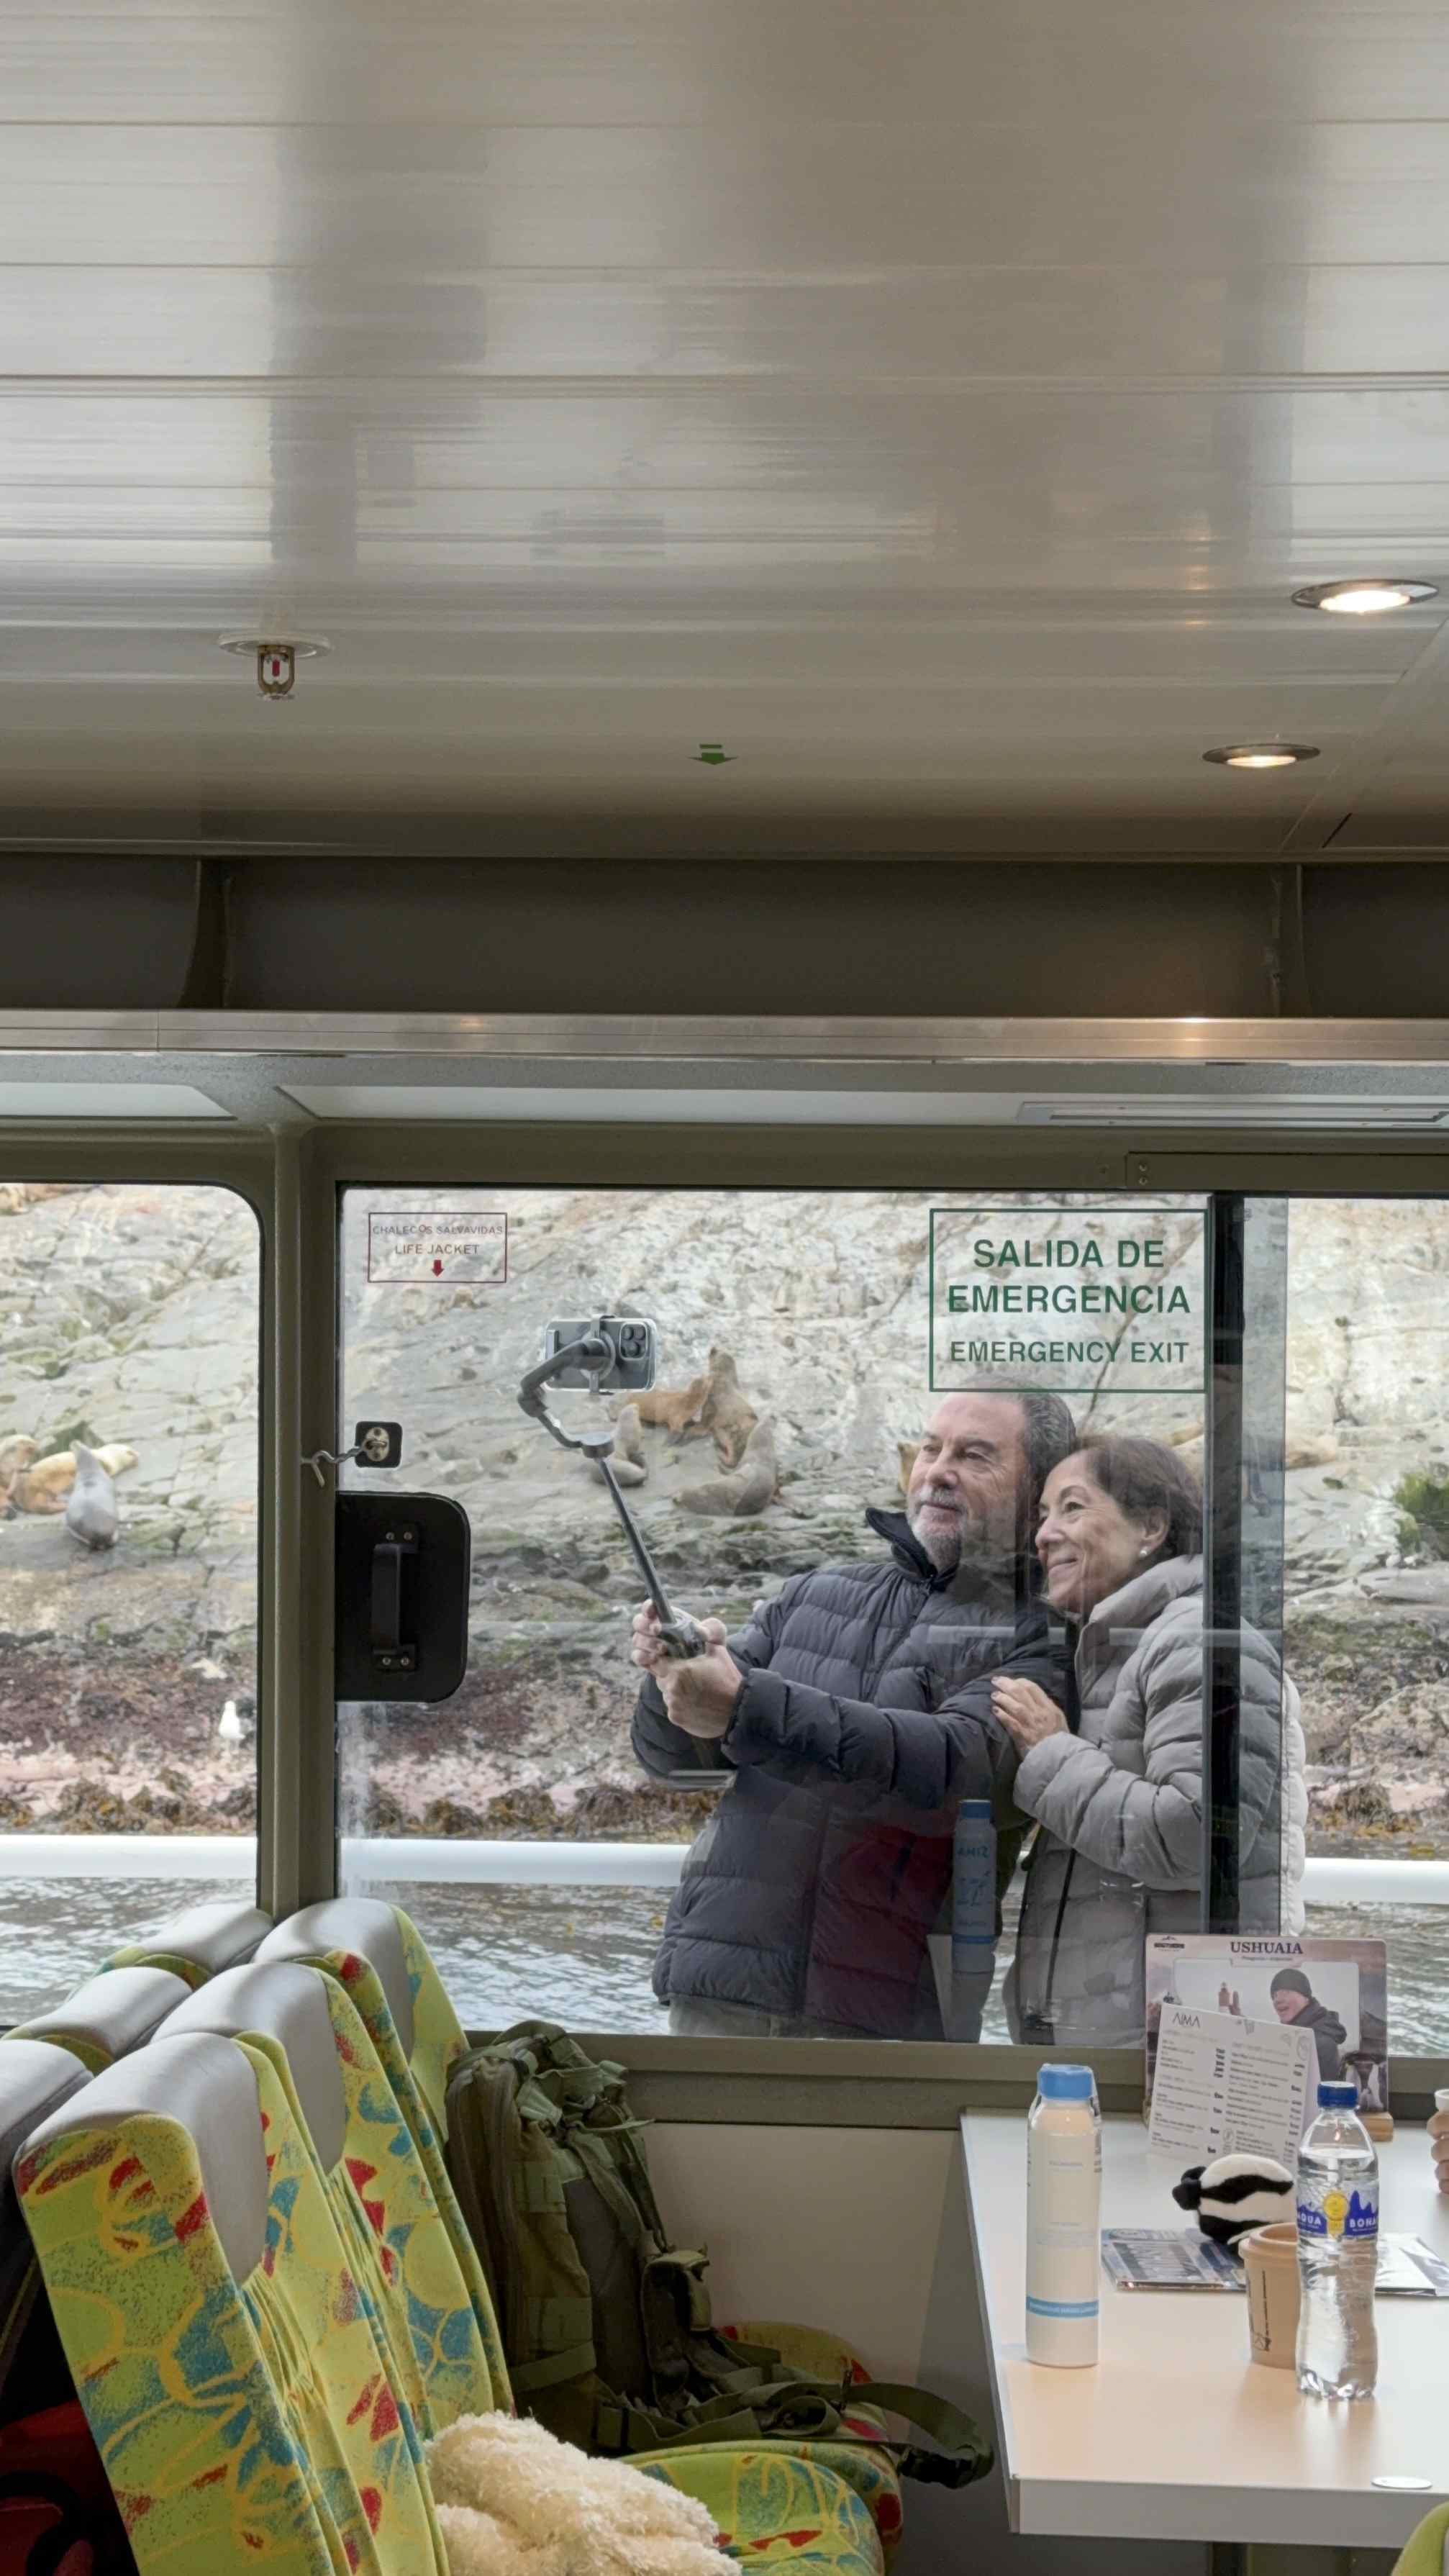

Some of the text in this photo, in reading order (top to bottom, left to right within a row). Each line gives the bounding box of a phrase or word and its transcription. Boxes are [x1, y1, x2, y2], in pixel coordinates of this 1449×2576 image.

[373, 1225, 503, 1235] CHALECOS SALVAVIDAS
[396, 1244, 480, 1255] LIFE JACKET
[973, 1240, 1164, 1268] SALIDA DE
[948, 1285, 1191, 1313] EMERGENCIA
[950, 1341, 1189, 1363] EMERGENCY EXIT
[1230, 1941, 1304, 1954] USHUAIA
